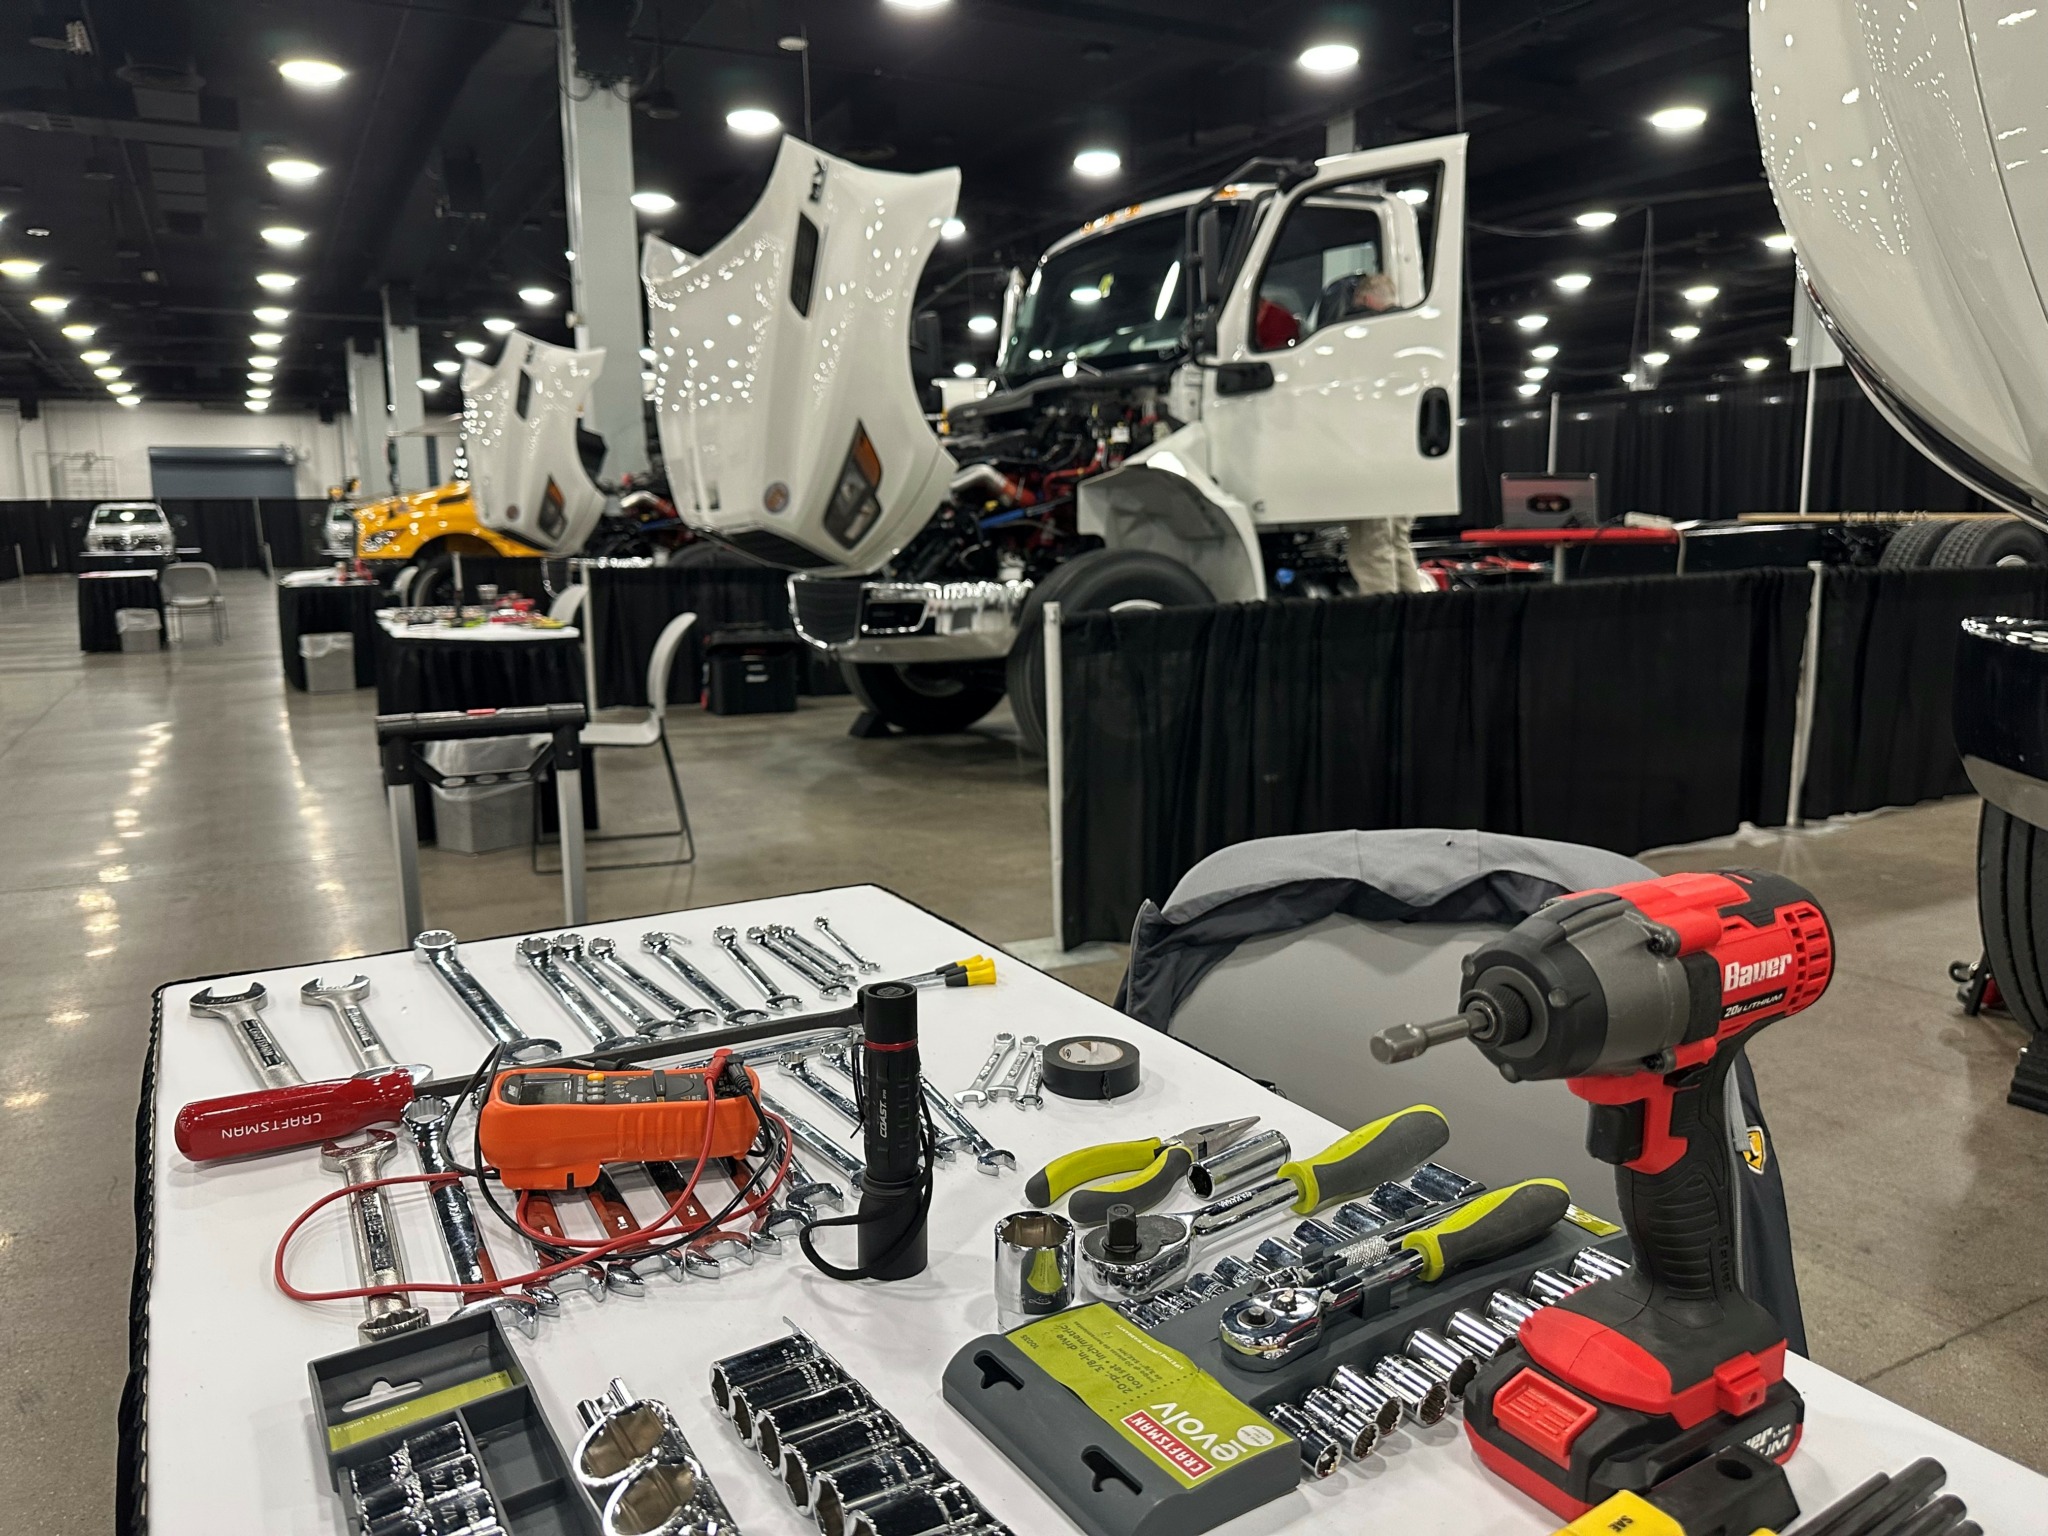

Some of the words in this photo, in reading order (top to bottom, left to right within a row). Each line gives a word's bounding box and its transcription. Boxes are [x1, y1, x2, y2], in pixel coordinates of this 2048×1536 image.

[1723, 953, 1792, 992] Bauer
[1743, 993, 1783, 1011] LITHIUM
[221, 1112, 322, 1139] CRAFTSMAN
[879, 1100, 887, 1138] COAST
[1056, 1333, 1079, 1350] drive
[1056, 1324, 1107, 1360] inch/metric
[1109, 1363, 1125, 1374] set
[1122, 1373, 1143, 1389] tool
[1130, 1416, 1204, 1473] CRAFTSMAN
[1150, 1402, 1248, 1462] evolv
[1608, 1515, 1634, 1533] SAE
